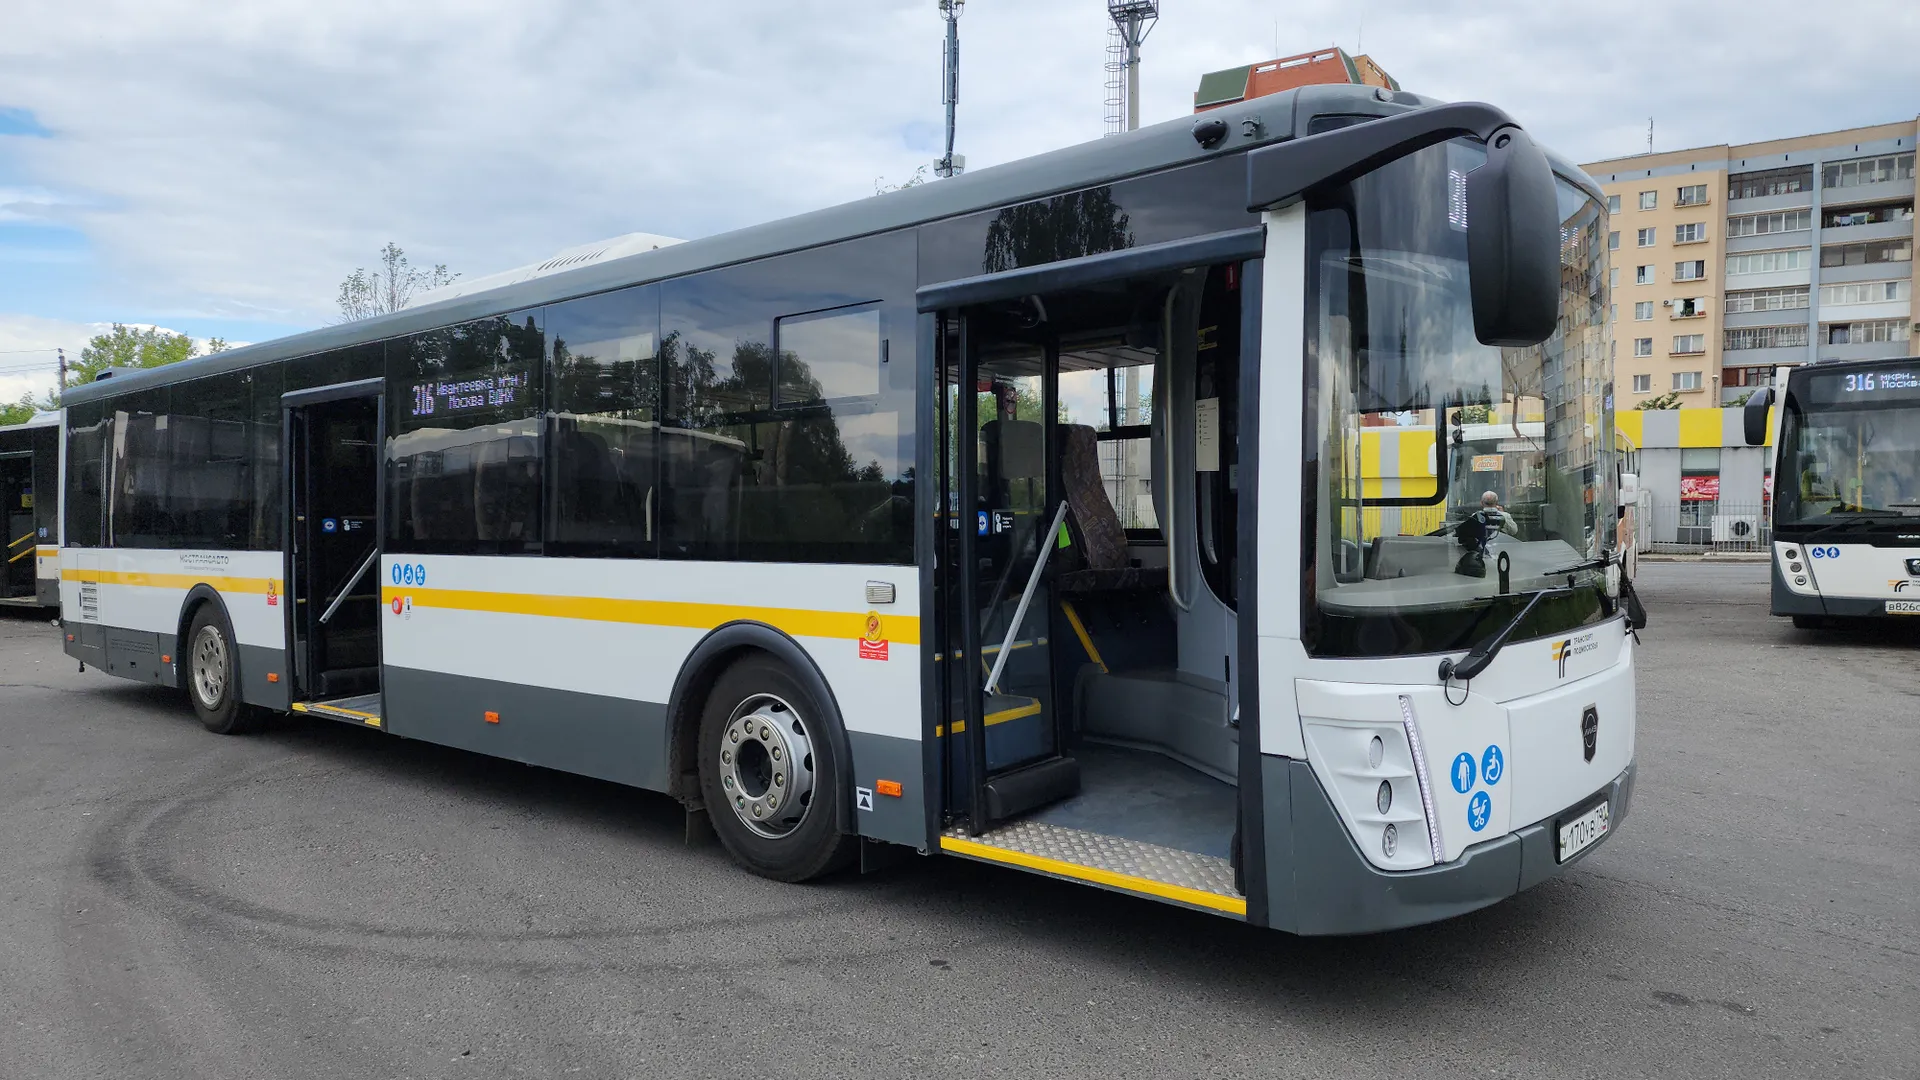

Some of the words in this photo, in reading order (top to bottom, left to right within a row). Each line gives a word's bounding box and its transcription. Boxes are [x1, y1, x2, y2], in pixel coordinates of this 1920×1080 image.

[1845, 373, 1875, 392] 316
[1881, 380, 1920, 389] Москв
[412, 383, 435, 415] 316
[448, 395, 485, 410] Москва
